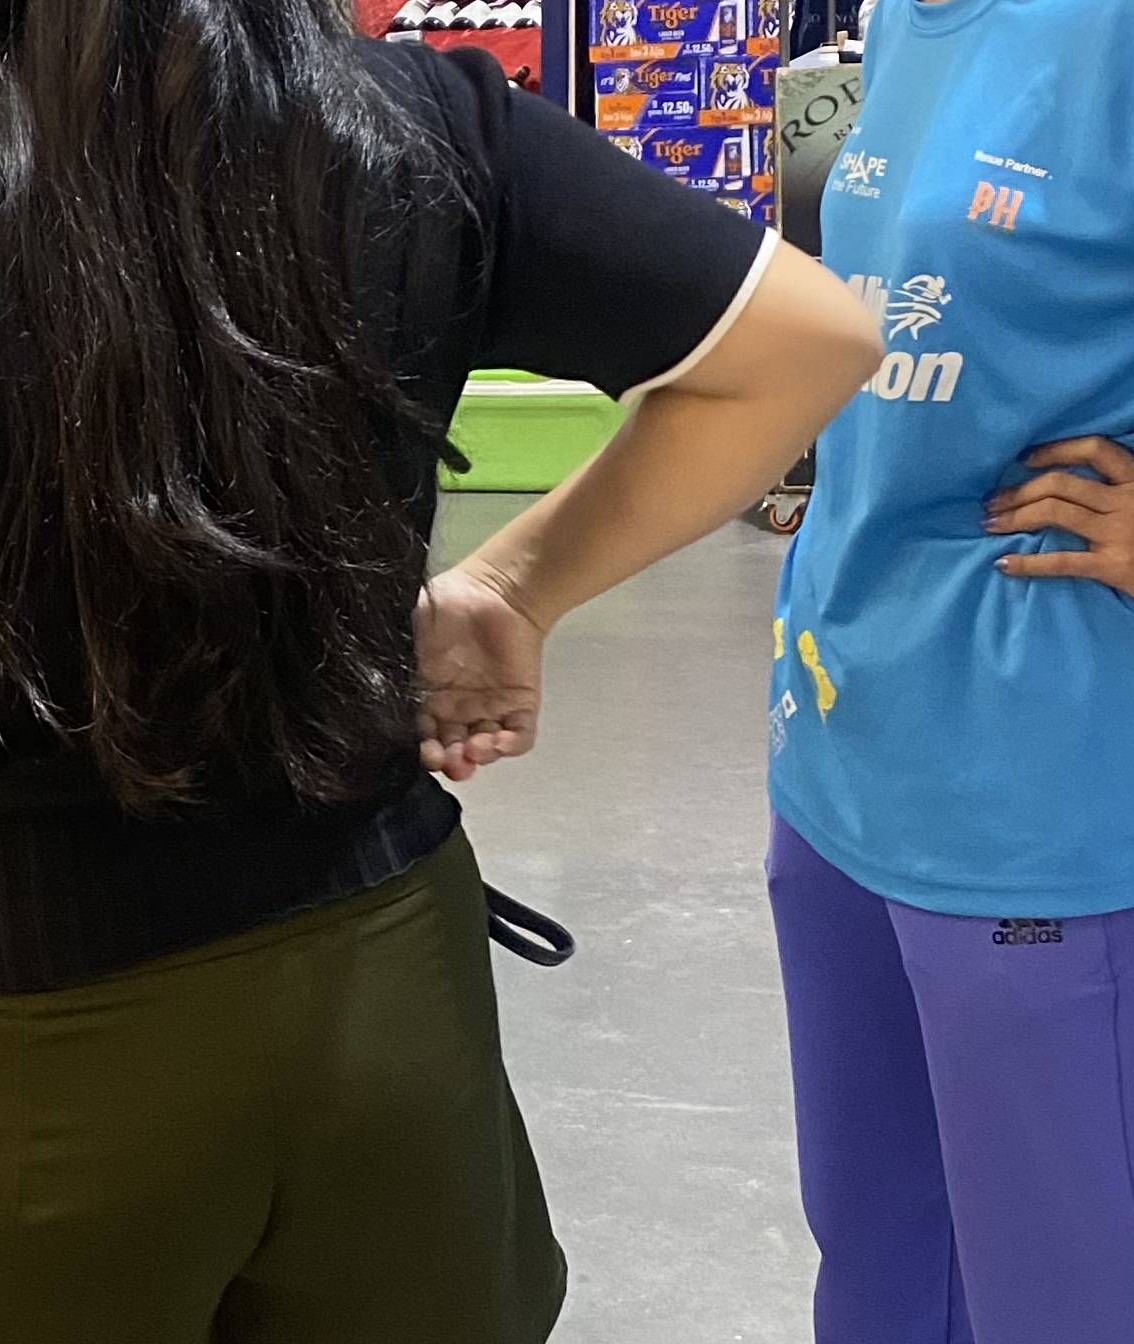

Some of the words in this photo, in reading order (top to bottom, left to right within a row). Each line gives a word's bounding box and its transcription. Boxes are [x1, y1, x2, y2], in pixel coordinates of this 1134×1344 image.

[648, 2, 698, 29] Tiger
[636, 66, 675, 88] Tiger
[652, 138, 703, 163] Tiger
[840, 150, 887, 184] SHAPE
[846, 179, 881, 198] Future
[967, 181, 1023, 230] PH
[866, 351, 963, 401] on
[992, 926, 1063, 944] adidas
